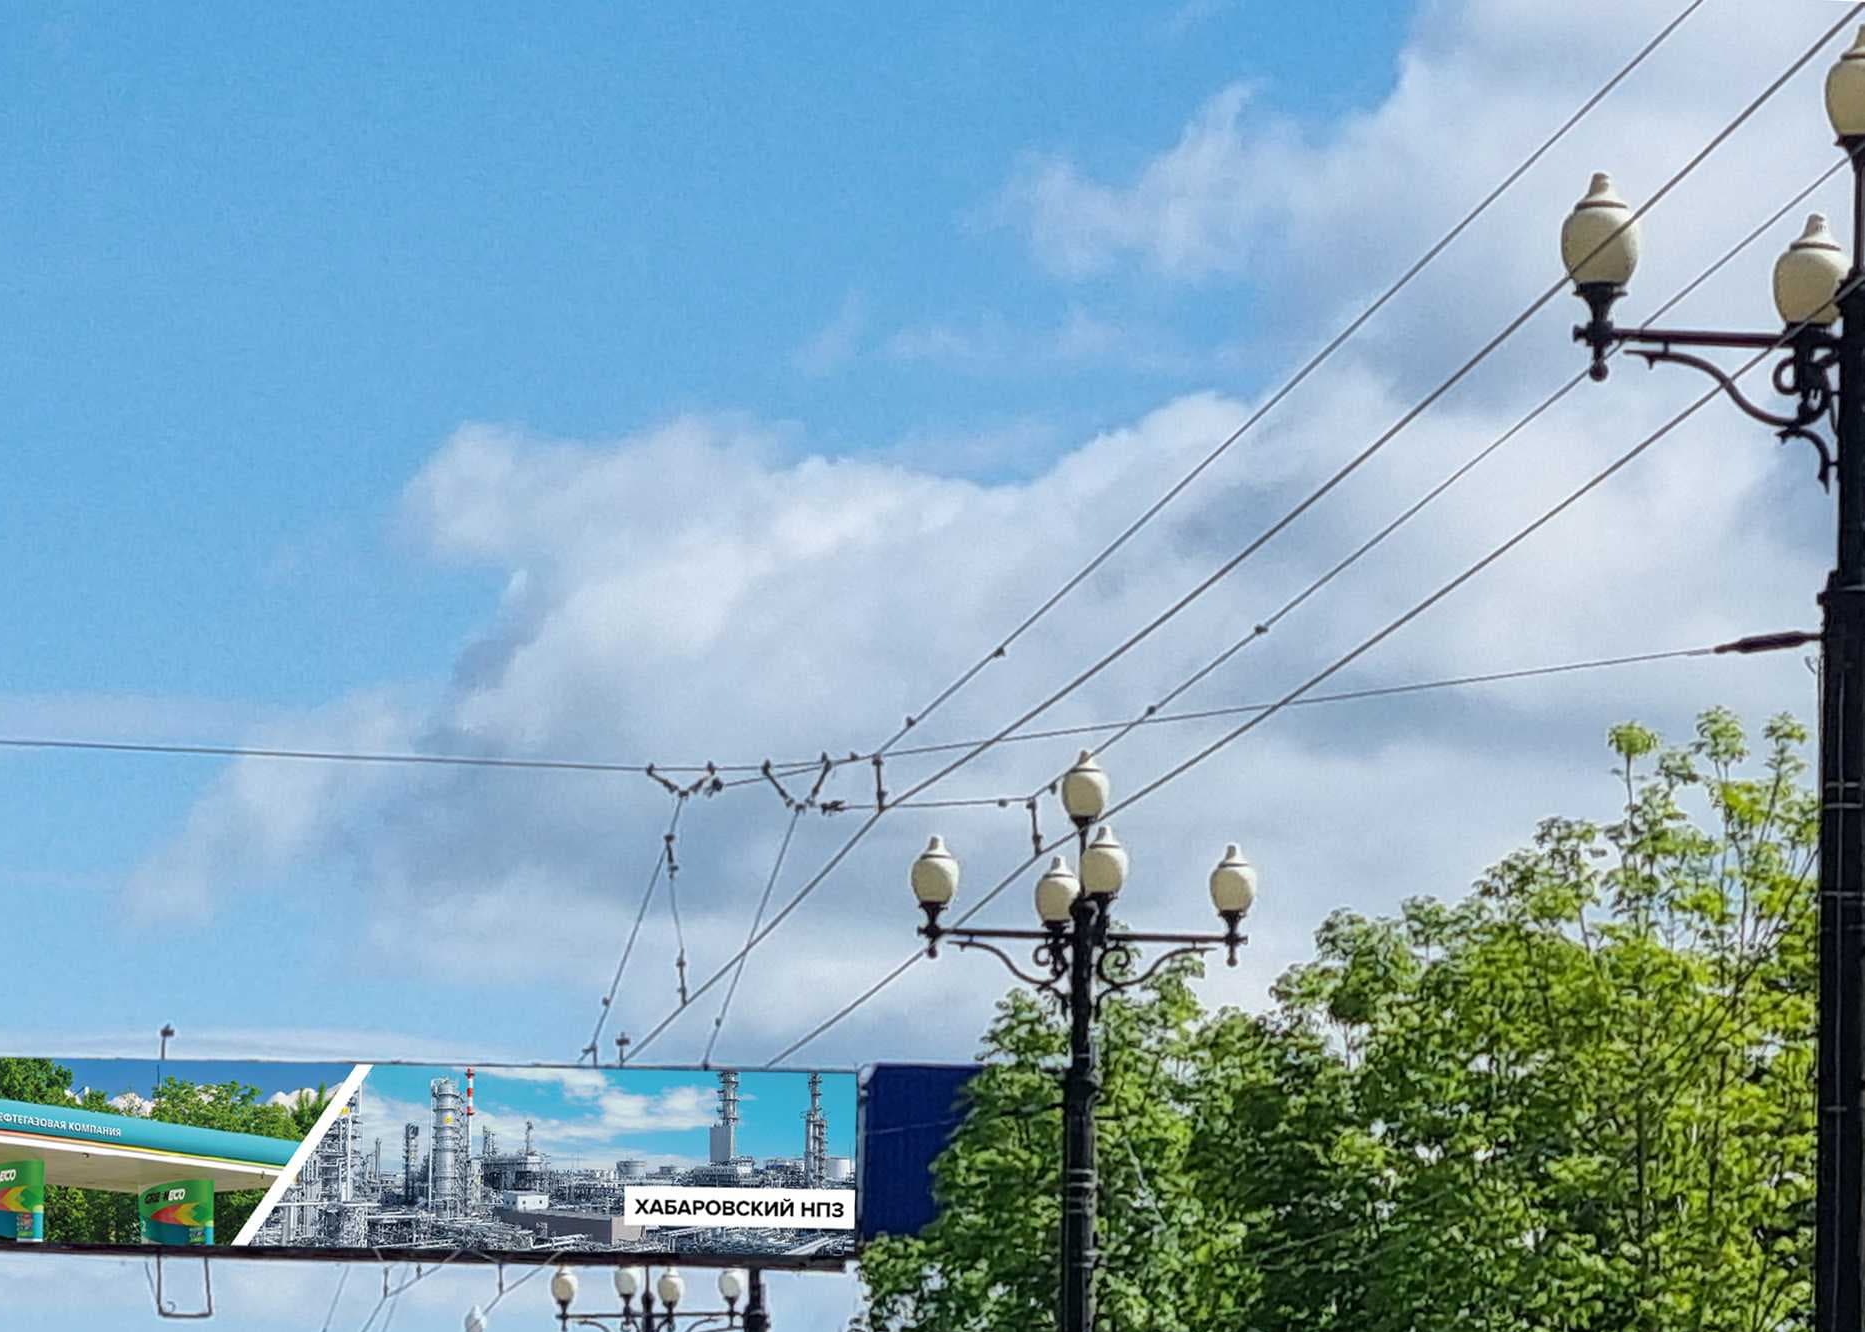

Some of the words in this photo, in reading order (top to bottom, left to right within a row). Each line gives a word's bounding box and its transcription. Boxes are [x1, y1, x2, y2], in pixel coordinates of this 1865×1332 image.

[68, 1121, 122, 1138] КОМПАНИЯ
[634, 1198, 794, 1217] ХАБАРОВСКИЙ
[801, 1202, 845, 1218] НПЗ
